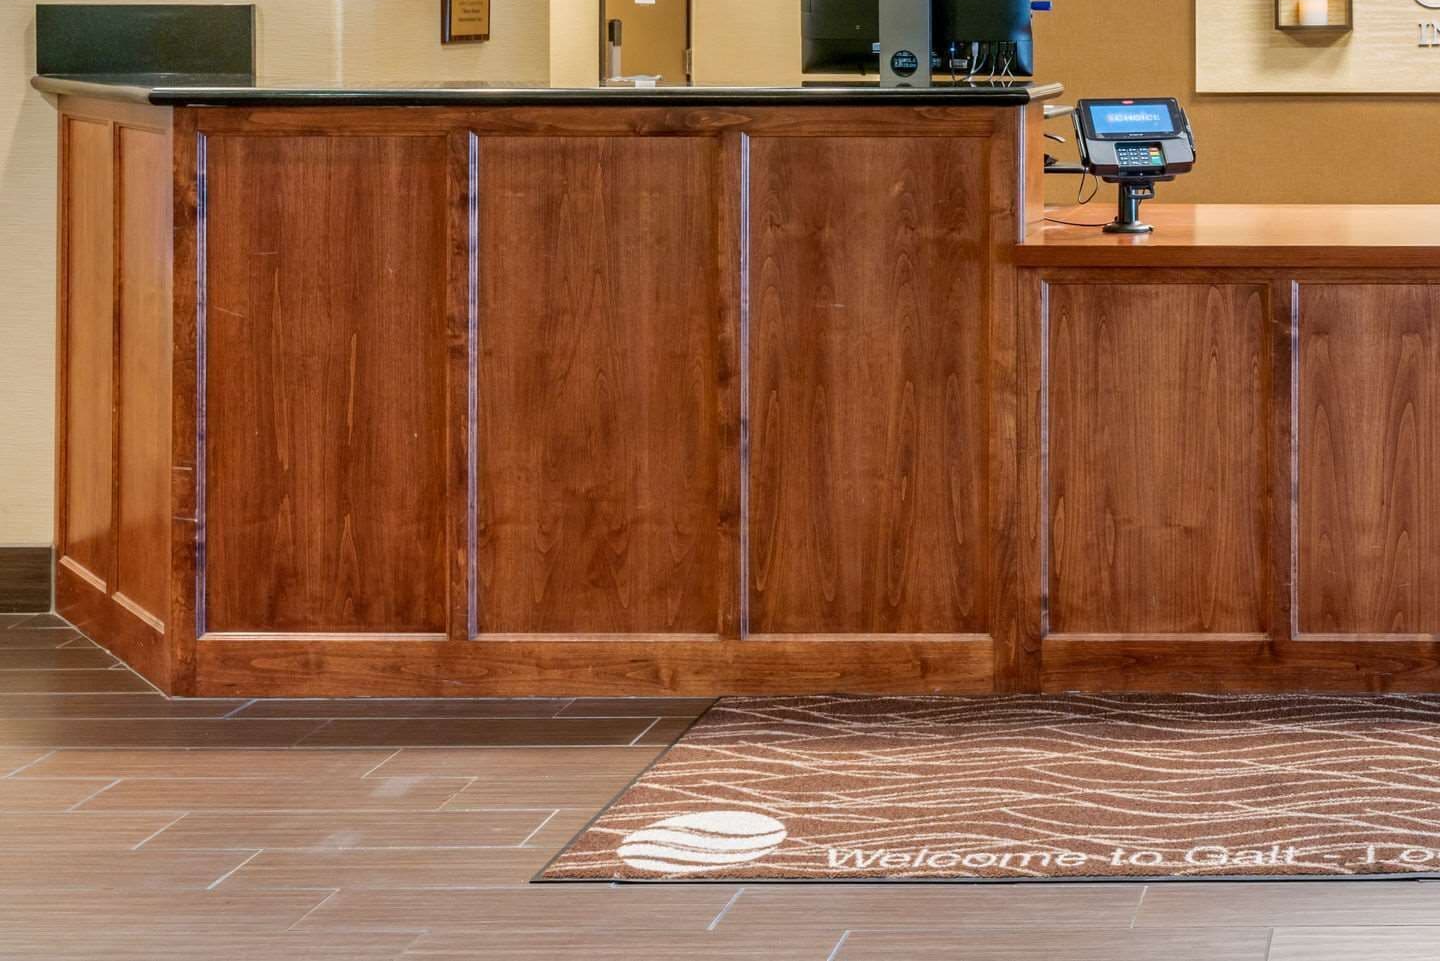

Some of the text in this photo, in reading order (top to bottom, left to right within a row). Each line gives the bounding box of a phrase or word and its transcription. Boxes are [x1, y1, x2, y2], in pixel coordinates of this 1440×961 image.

[826, 847, 1089, 868] Welcome
[1110, 847, 1163, 866] to
[1184, 845, 1297, 867] Galt
